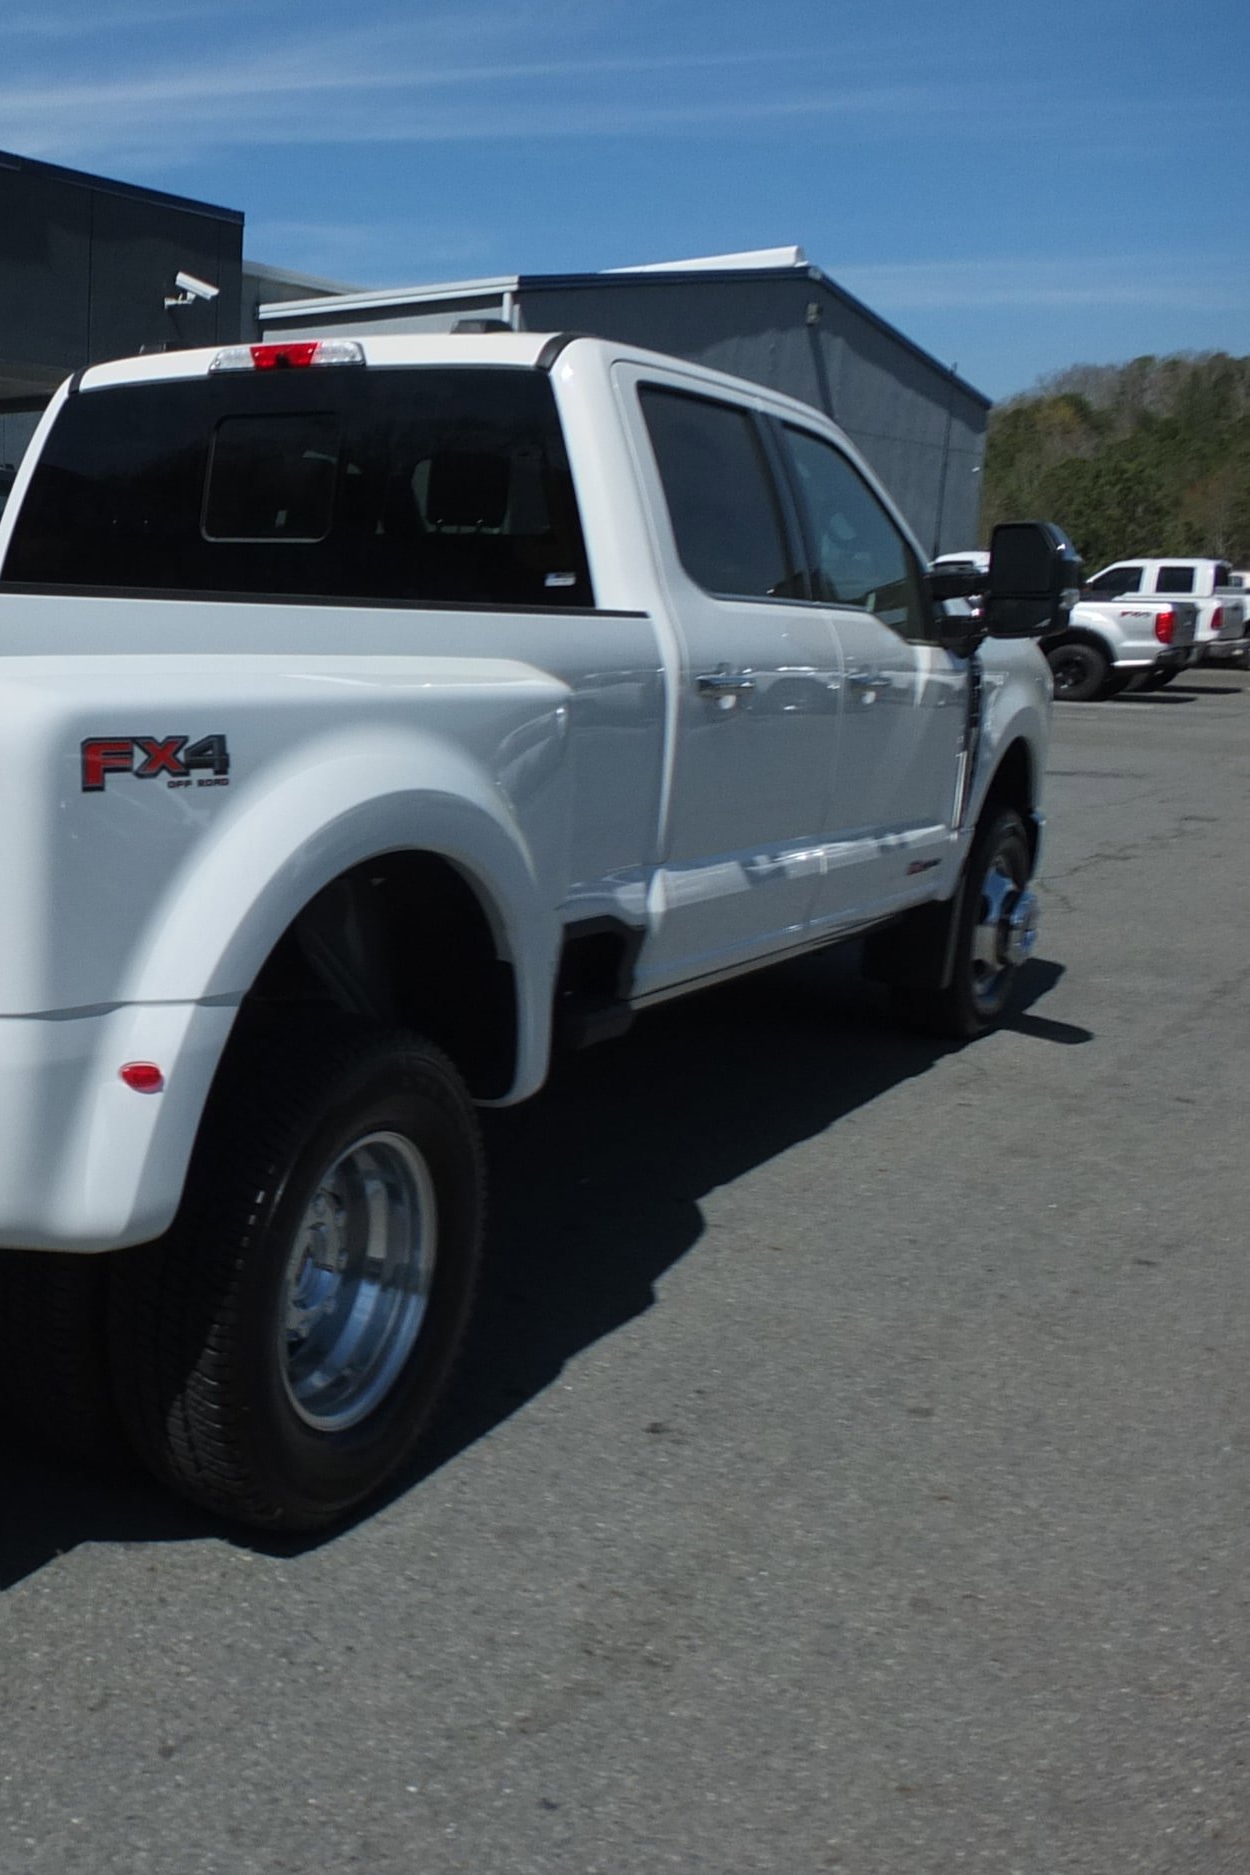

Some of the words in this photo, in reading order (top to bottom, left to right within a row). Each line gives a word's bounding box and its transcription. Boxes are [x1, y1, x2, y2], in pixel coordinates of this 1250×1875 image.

[80, 734, 230, 793] FX4
[167, 780, 192, 789] OFF
[197, 778, 230, 788] ROAD
